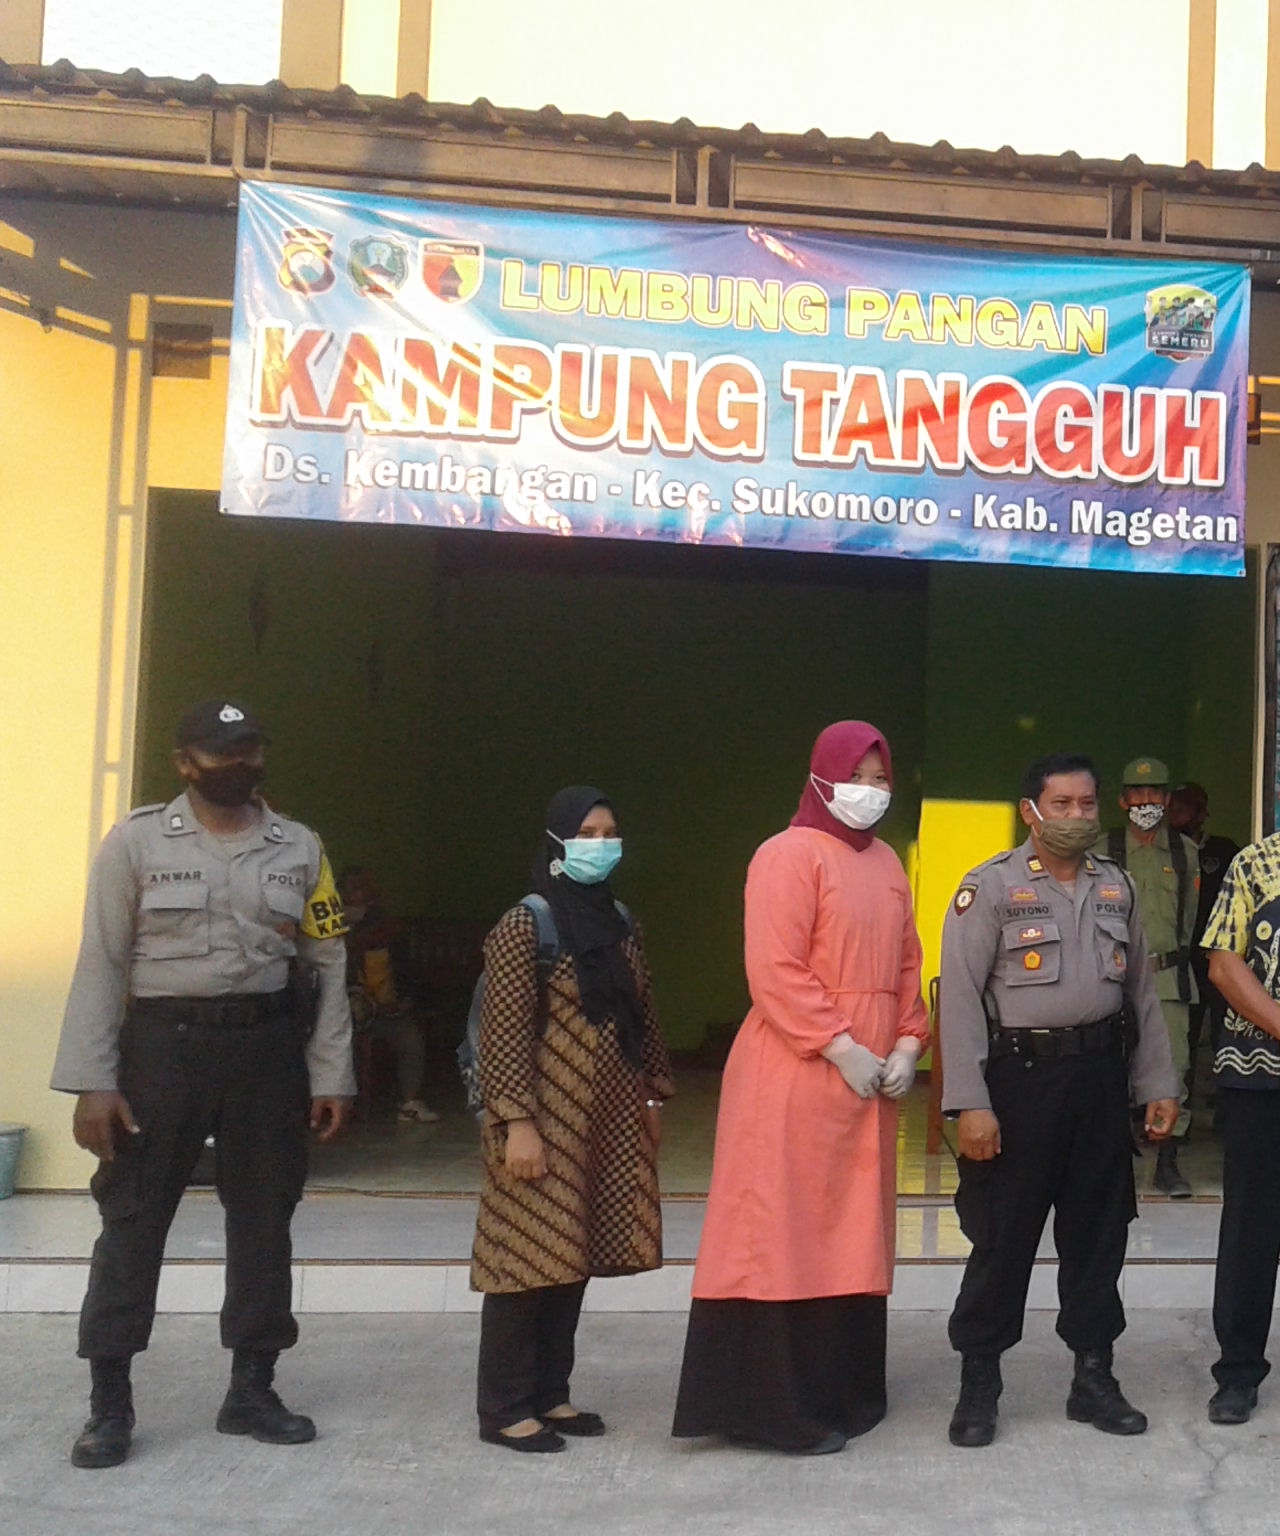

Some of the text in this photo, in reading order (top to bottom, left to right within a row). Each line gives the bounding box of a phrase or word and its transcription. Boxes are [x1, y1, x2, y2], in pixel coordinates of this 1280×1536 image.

[500, 258, 1108, 355] LUMBUNG PANGAN
[251, 319, 1226, 488] KAMPUNG TANGGUH
[263, 444, 330, 485] Ds.
[344, 449, 598, 507] Kembangan
[633, 469, 721, 513] Kec.
[733, 475, 939, 527] Sukomoro
[973, 493, 1059, 534] Kab.
[1071, 500, 1238, 546] Magetan
[150, 870, 203, 883] ANWAR
[1006, 904, 1050, 918] SUYONO
